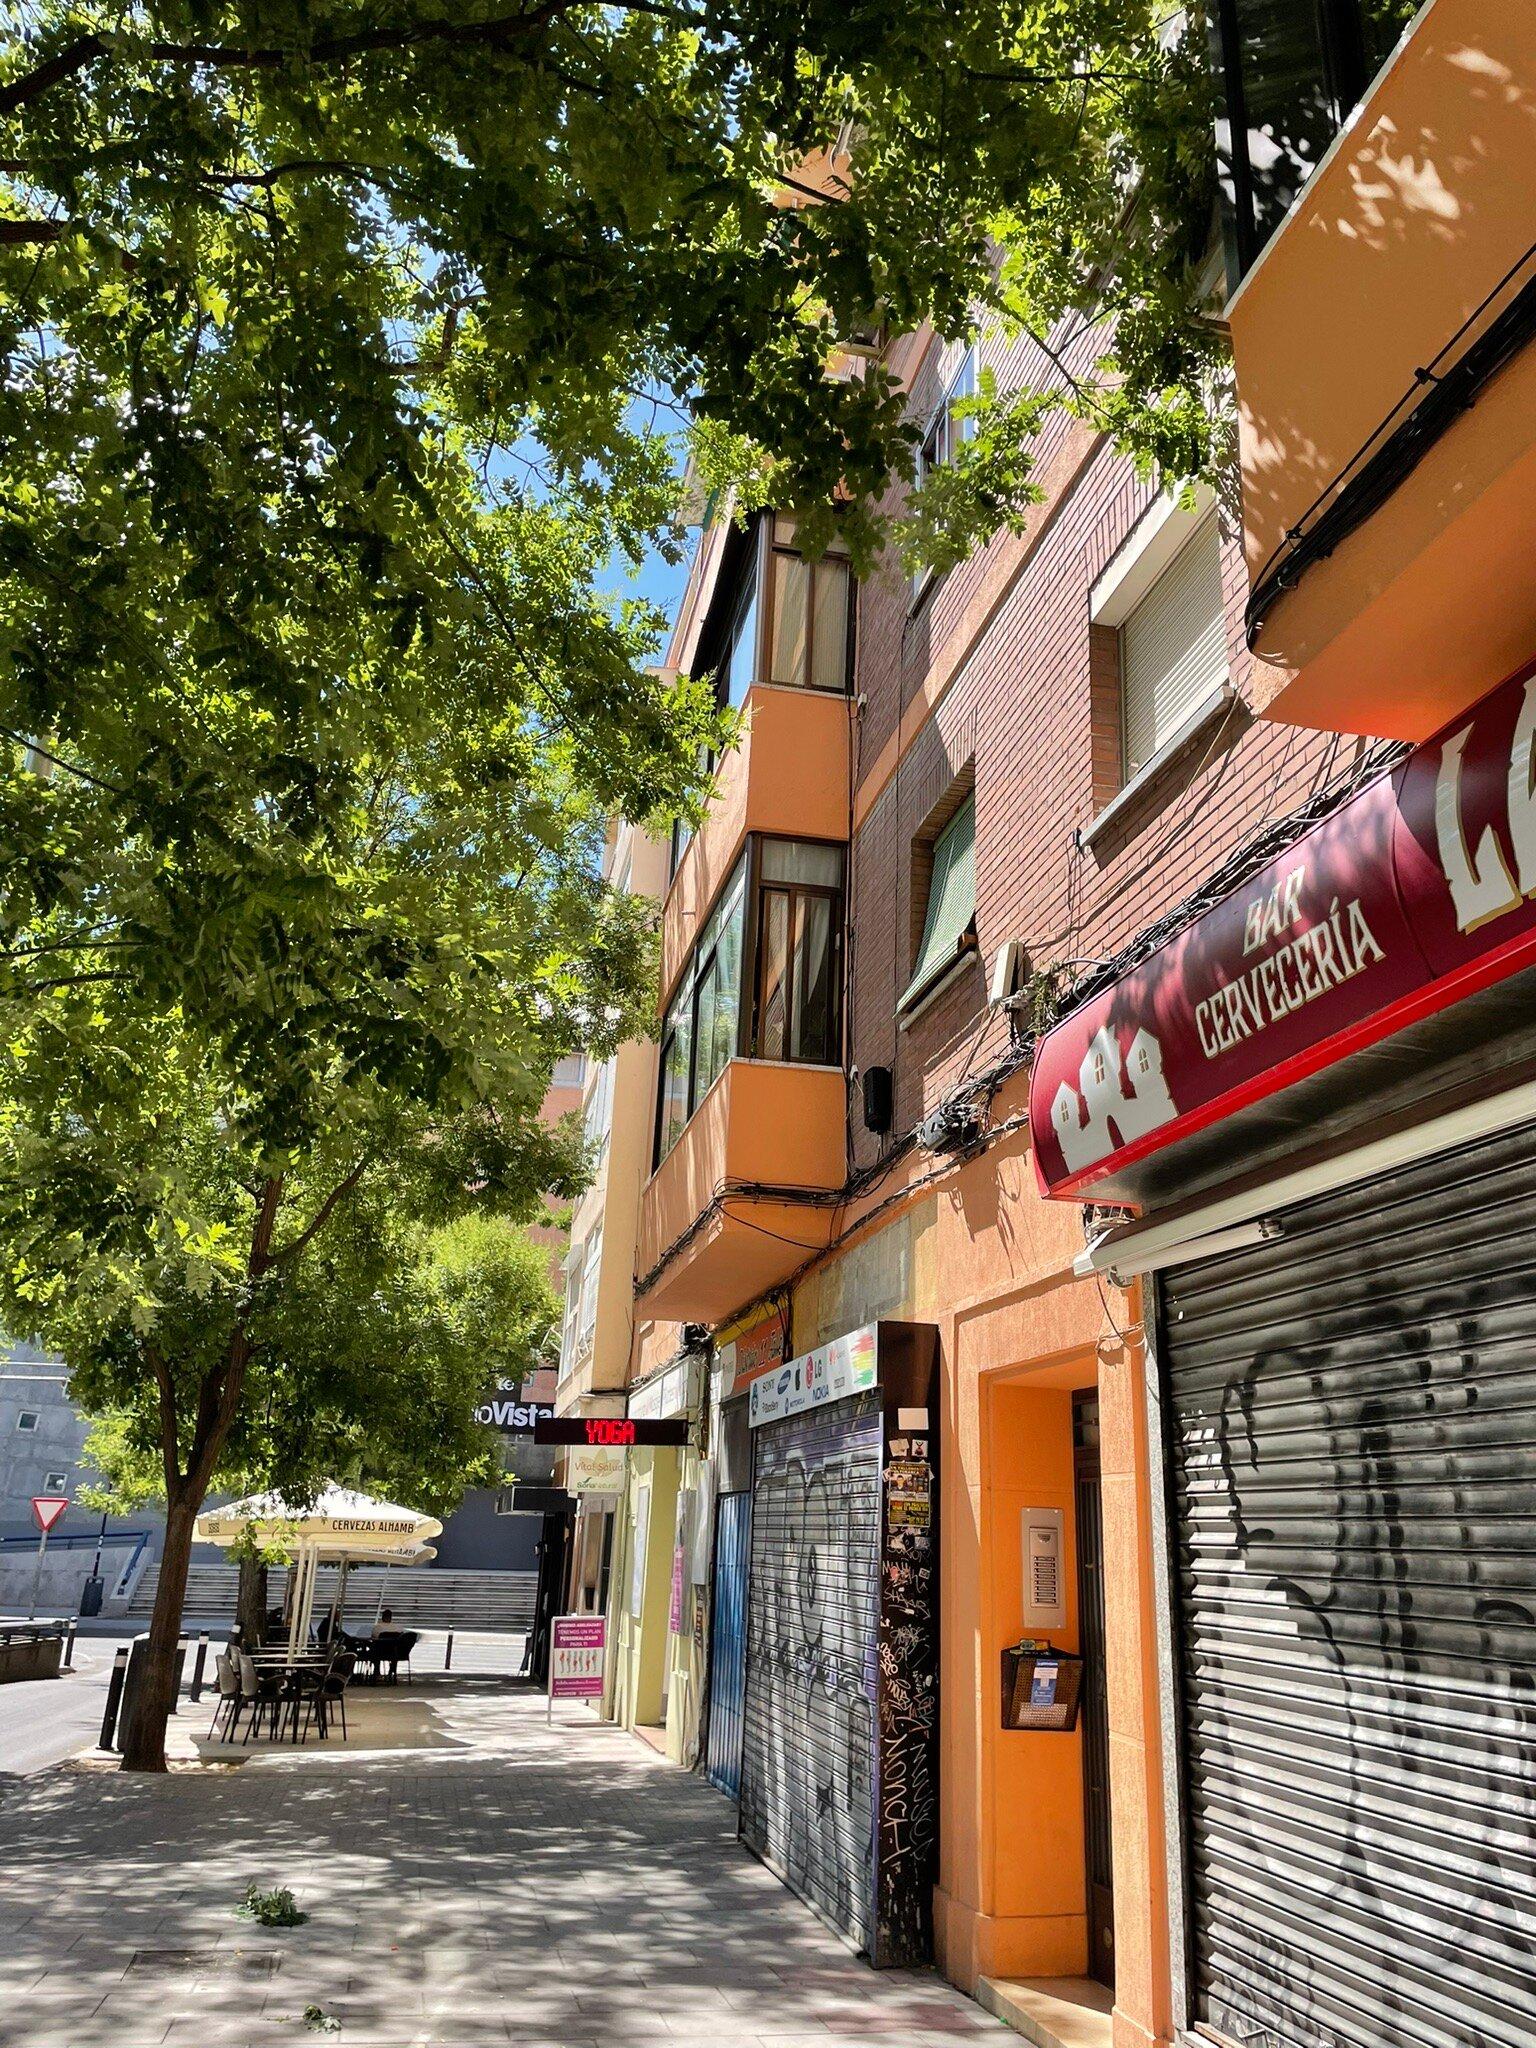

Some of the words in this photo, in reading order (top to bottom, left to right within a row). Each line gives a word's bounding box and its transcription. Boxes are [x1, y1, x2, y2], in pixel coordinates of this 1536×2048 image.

[1242, 865, 1306, 957] BAR
[1195, 896, 1387, 1060] CERVECERÍA
[585, 1420, 636, 1444] YOGA
[332, 1519, 376, 1532] CERVEZAS
